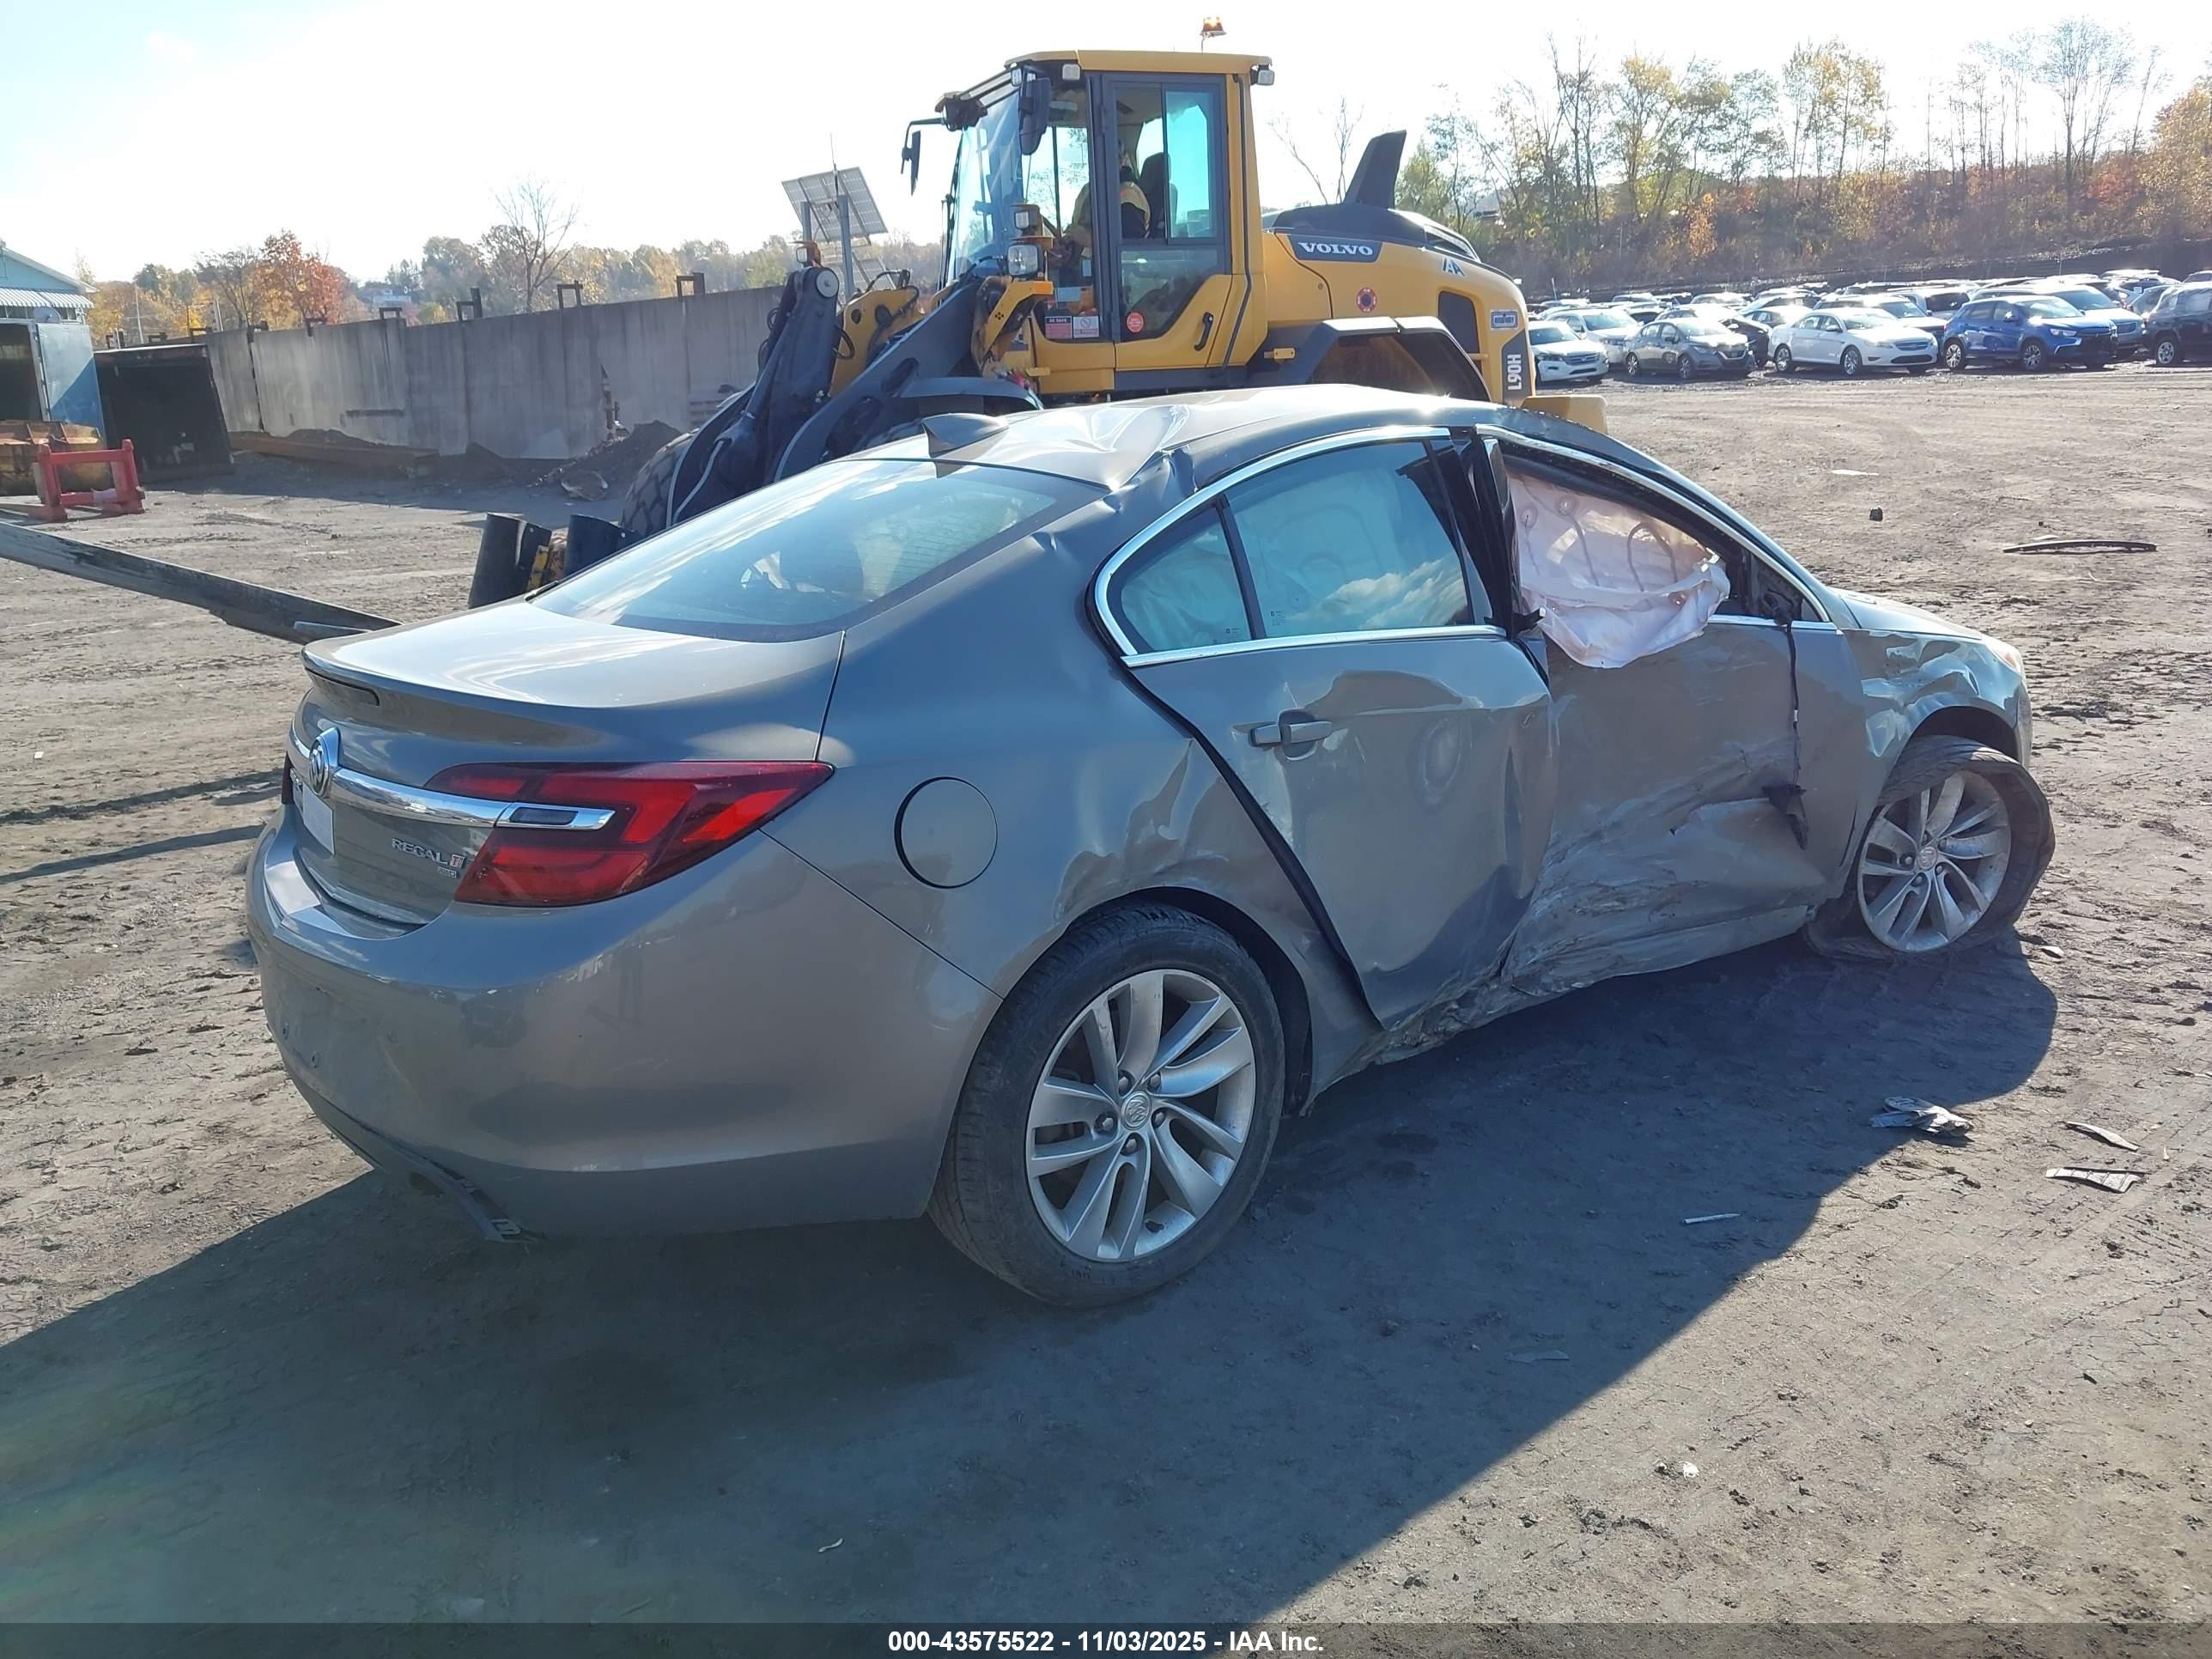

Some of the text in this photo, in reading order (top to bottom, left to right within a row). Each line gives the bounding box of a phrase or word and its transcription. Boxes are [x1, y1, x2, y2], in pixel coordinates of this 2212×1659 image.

[1297, 242, 1374, 256] VOLVO
[1507, 354, 1522, 391] L90H
[392, 838, 448, 866] REGAL
